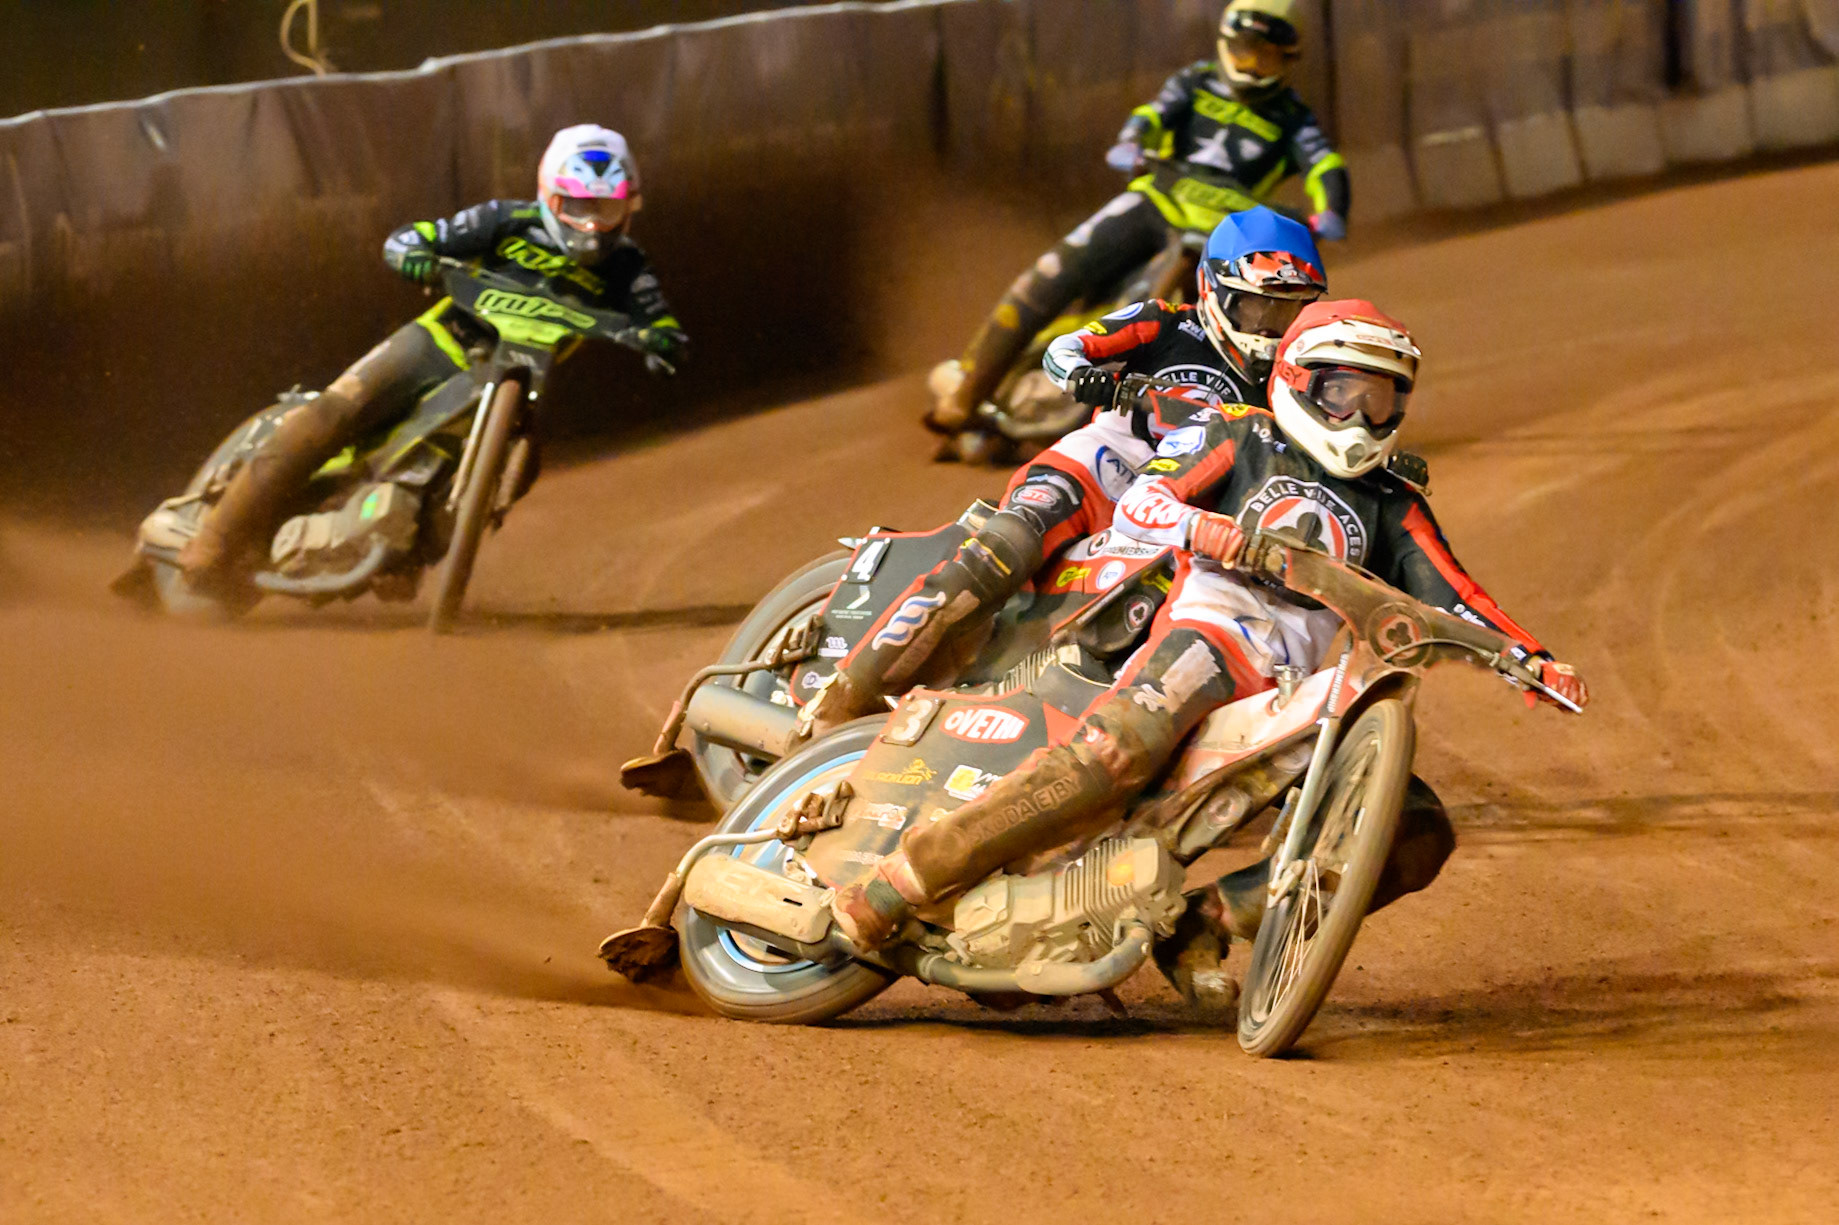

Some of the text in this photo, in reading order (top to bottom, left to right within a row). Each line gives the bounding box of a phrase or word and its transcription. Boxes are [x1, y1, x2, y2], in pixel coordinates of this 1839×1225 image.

[1250, 482, 1362, 556] BELLE VUE ACES
[851, 541, 884, 581] 4
[891, 700, 932, 740] 3
